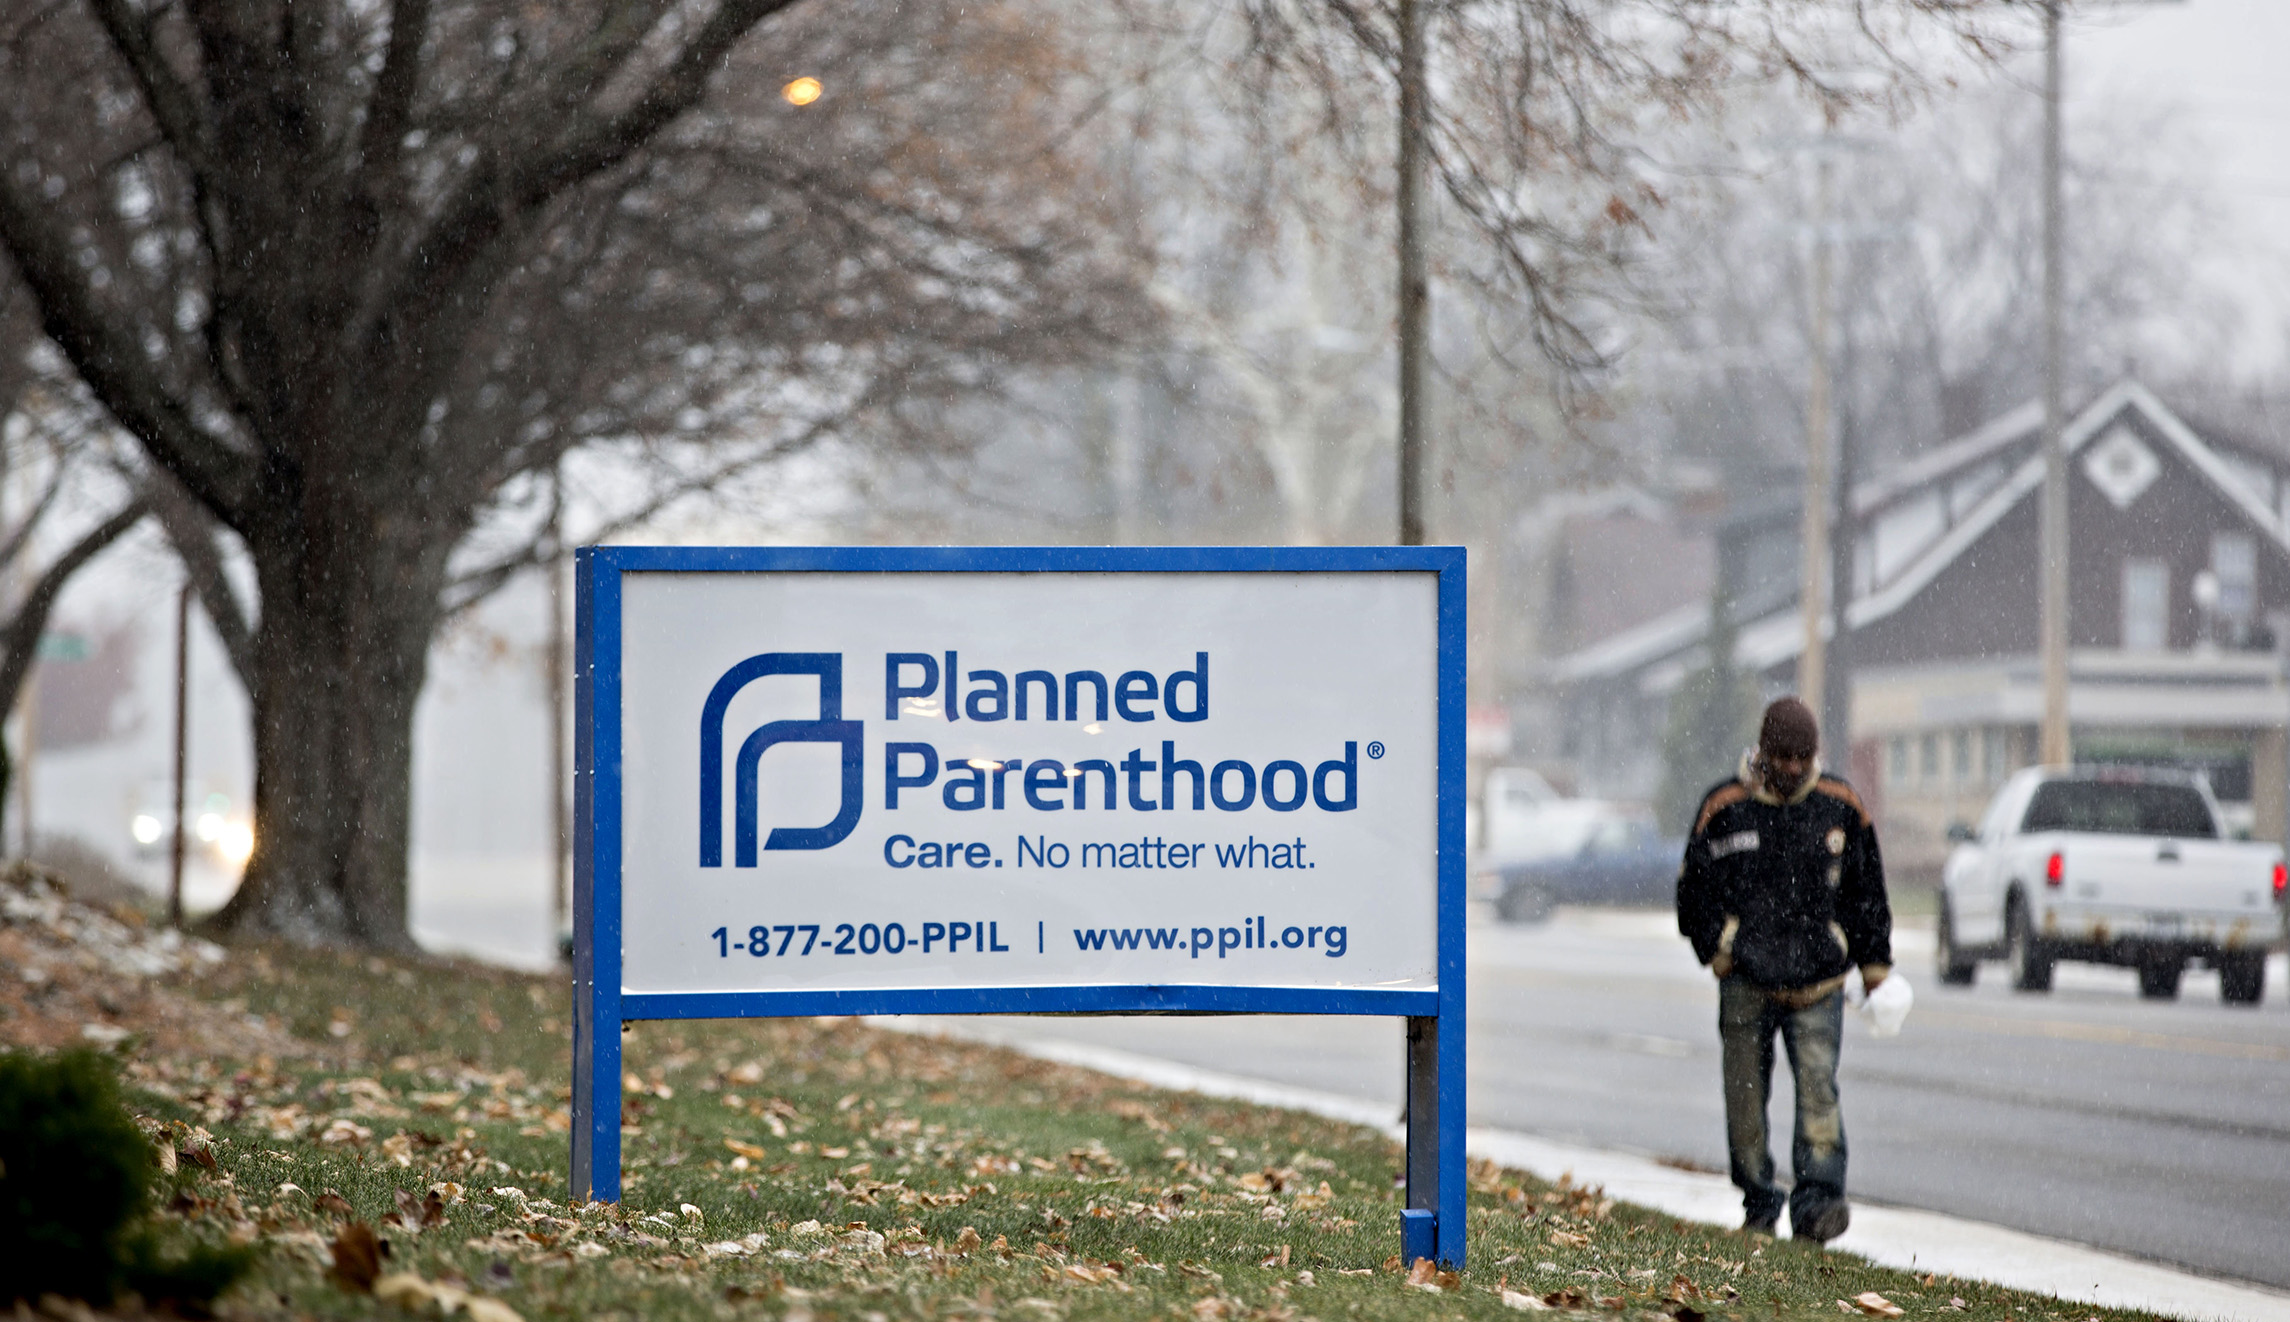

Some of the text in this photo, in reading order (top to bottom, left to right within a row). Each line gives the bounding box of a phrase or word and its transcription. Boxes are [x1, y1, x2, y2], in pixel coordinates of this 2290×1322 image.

[885, 650, 1209, 723] Planned
[883, 834, 1315, 870] Care. No matter what.
[711, 915, 1348, 959] 1-877-200-PPIL www.ppil.org
